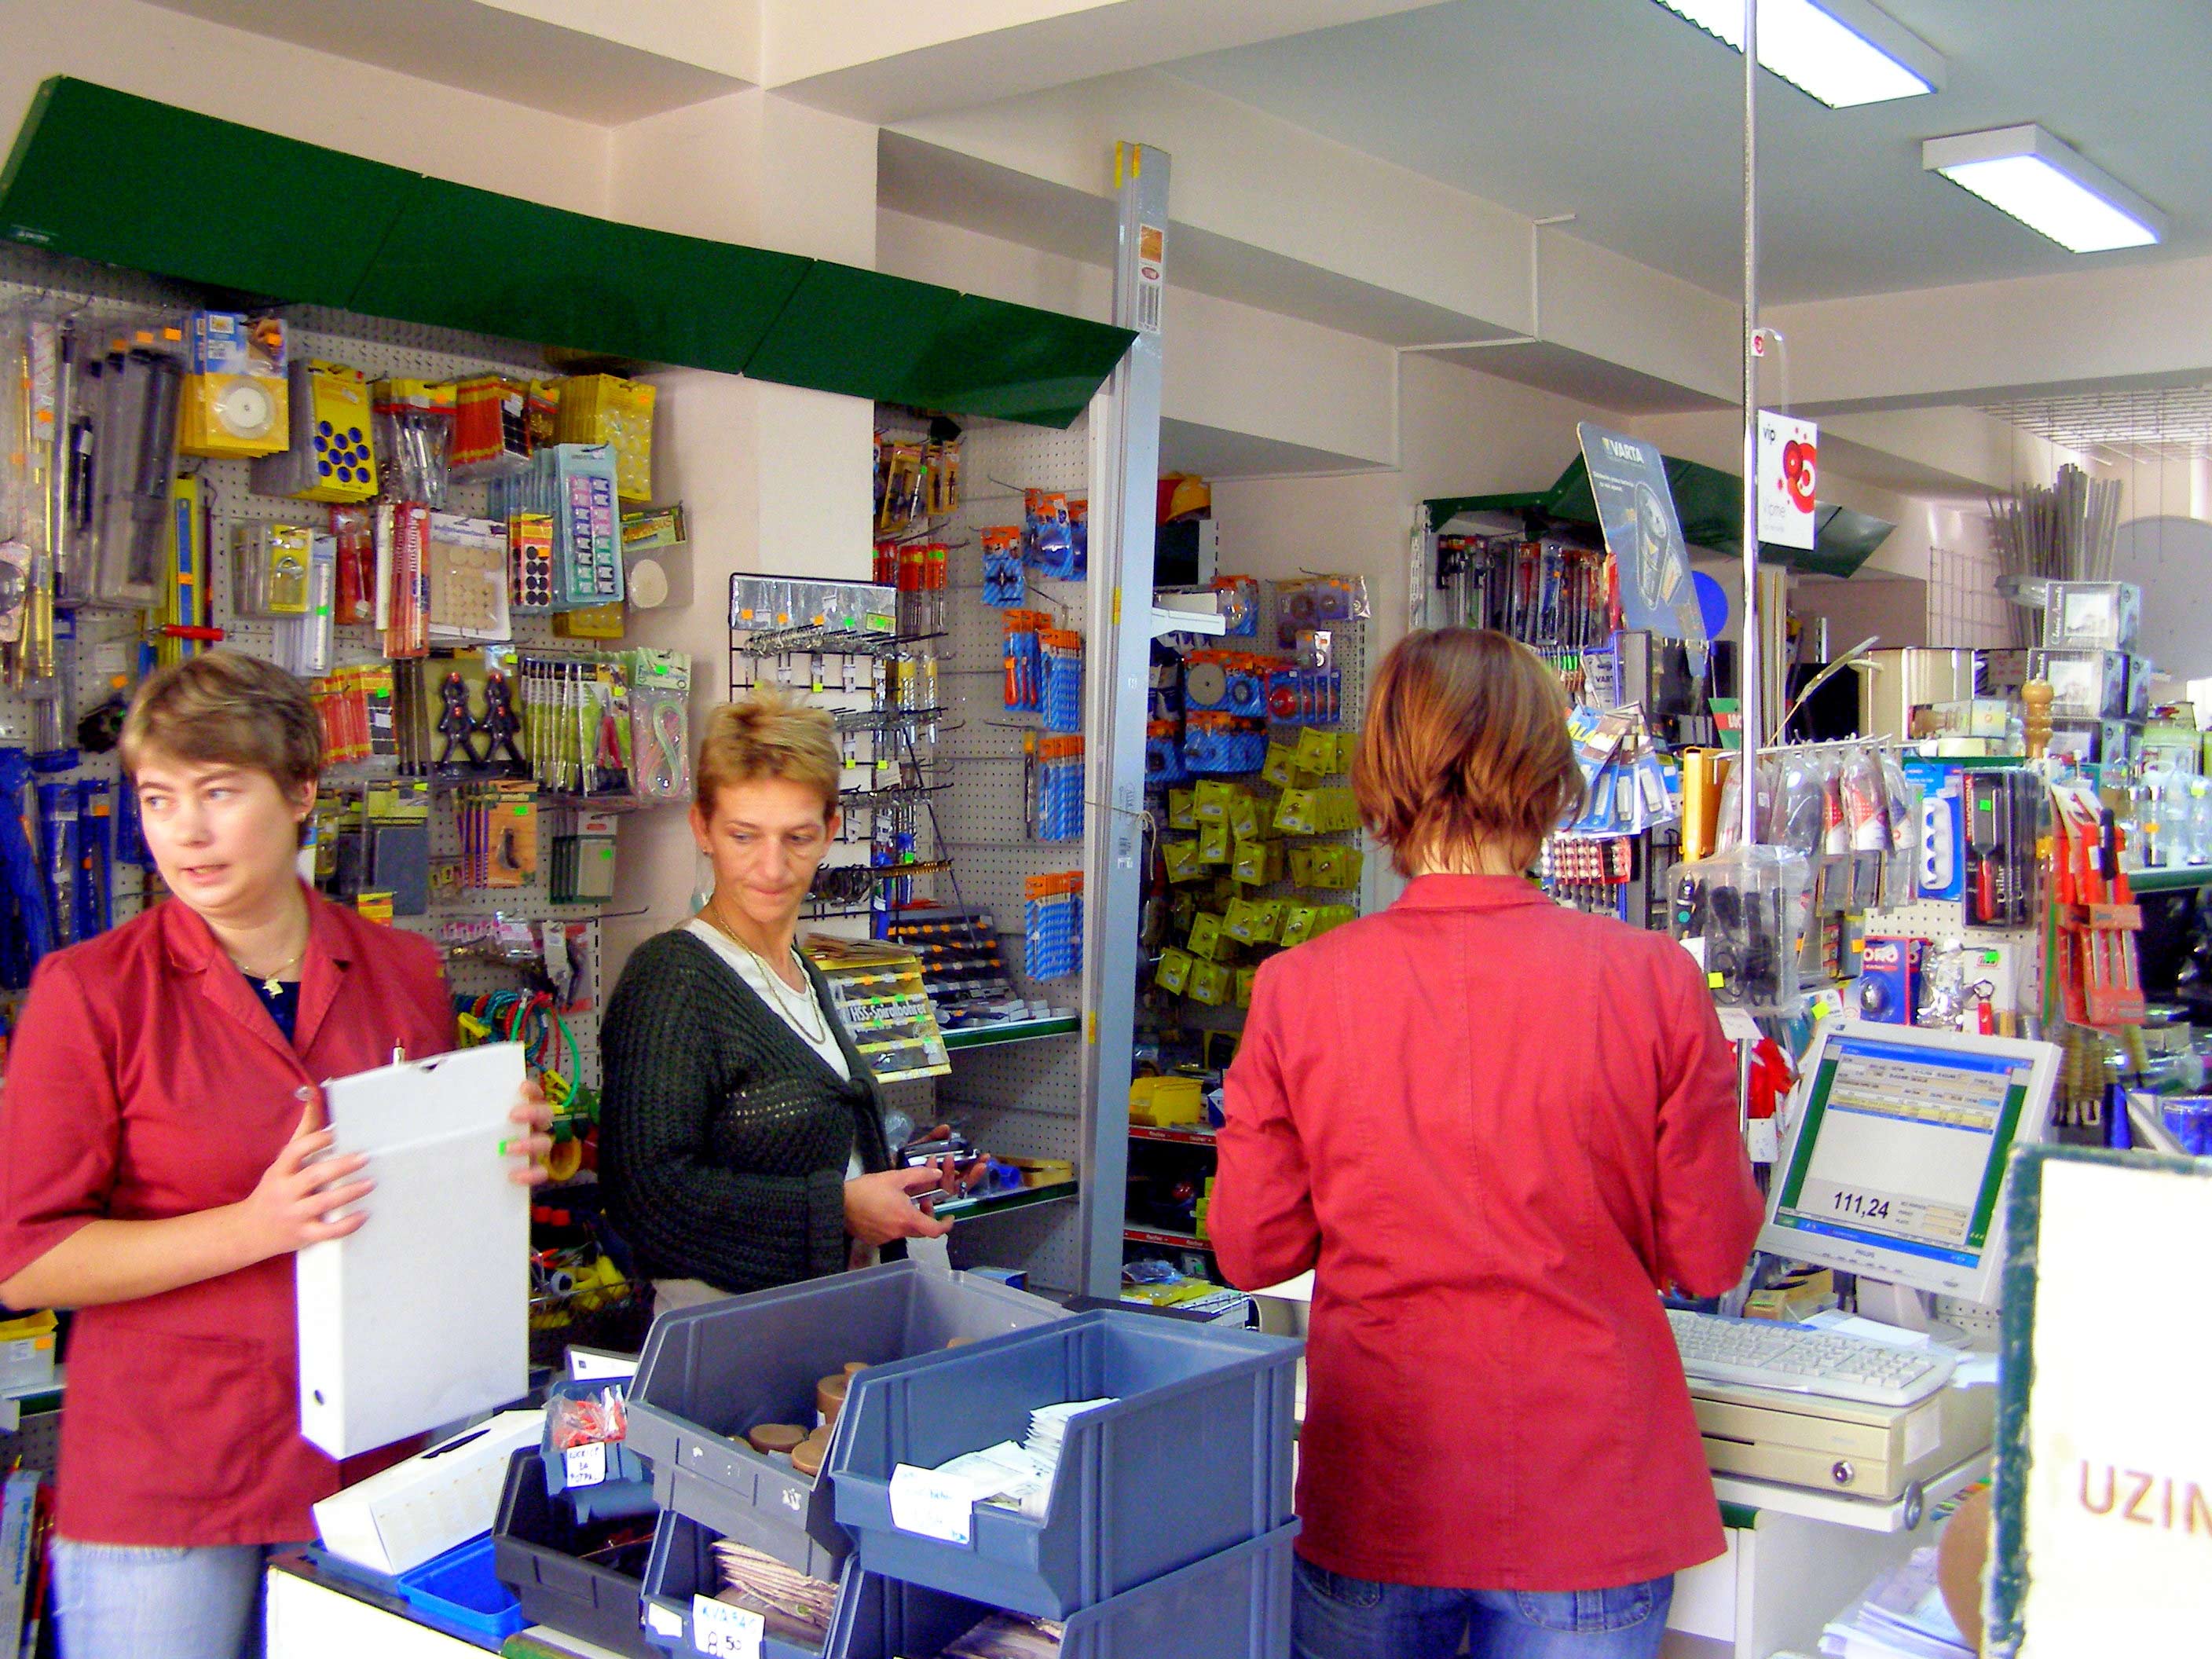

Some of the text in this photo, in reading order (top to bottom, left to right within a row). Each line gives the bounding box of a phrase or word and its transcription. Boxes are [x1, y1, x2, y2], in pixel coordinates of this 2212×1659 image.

[1763, 423, 1776, 445] vip
[1610, 439, 1644, 464] VARTA
[849, 1000, 927, 1022] HSS-Spiralbohrer
[1834, 1191, 1890, 1219] 111,24
